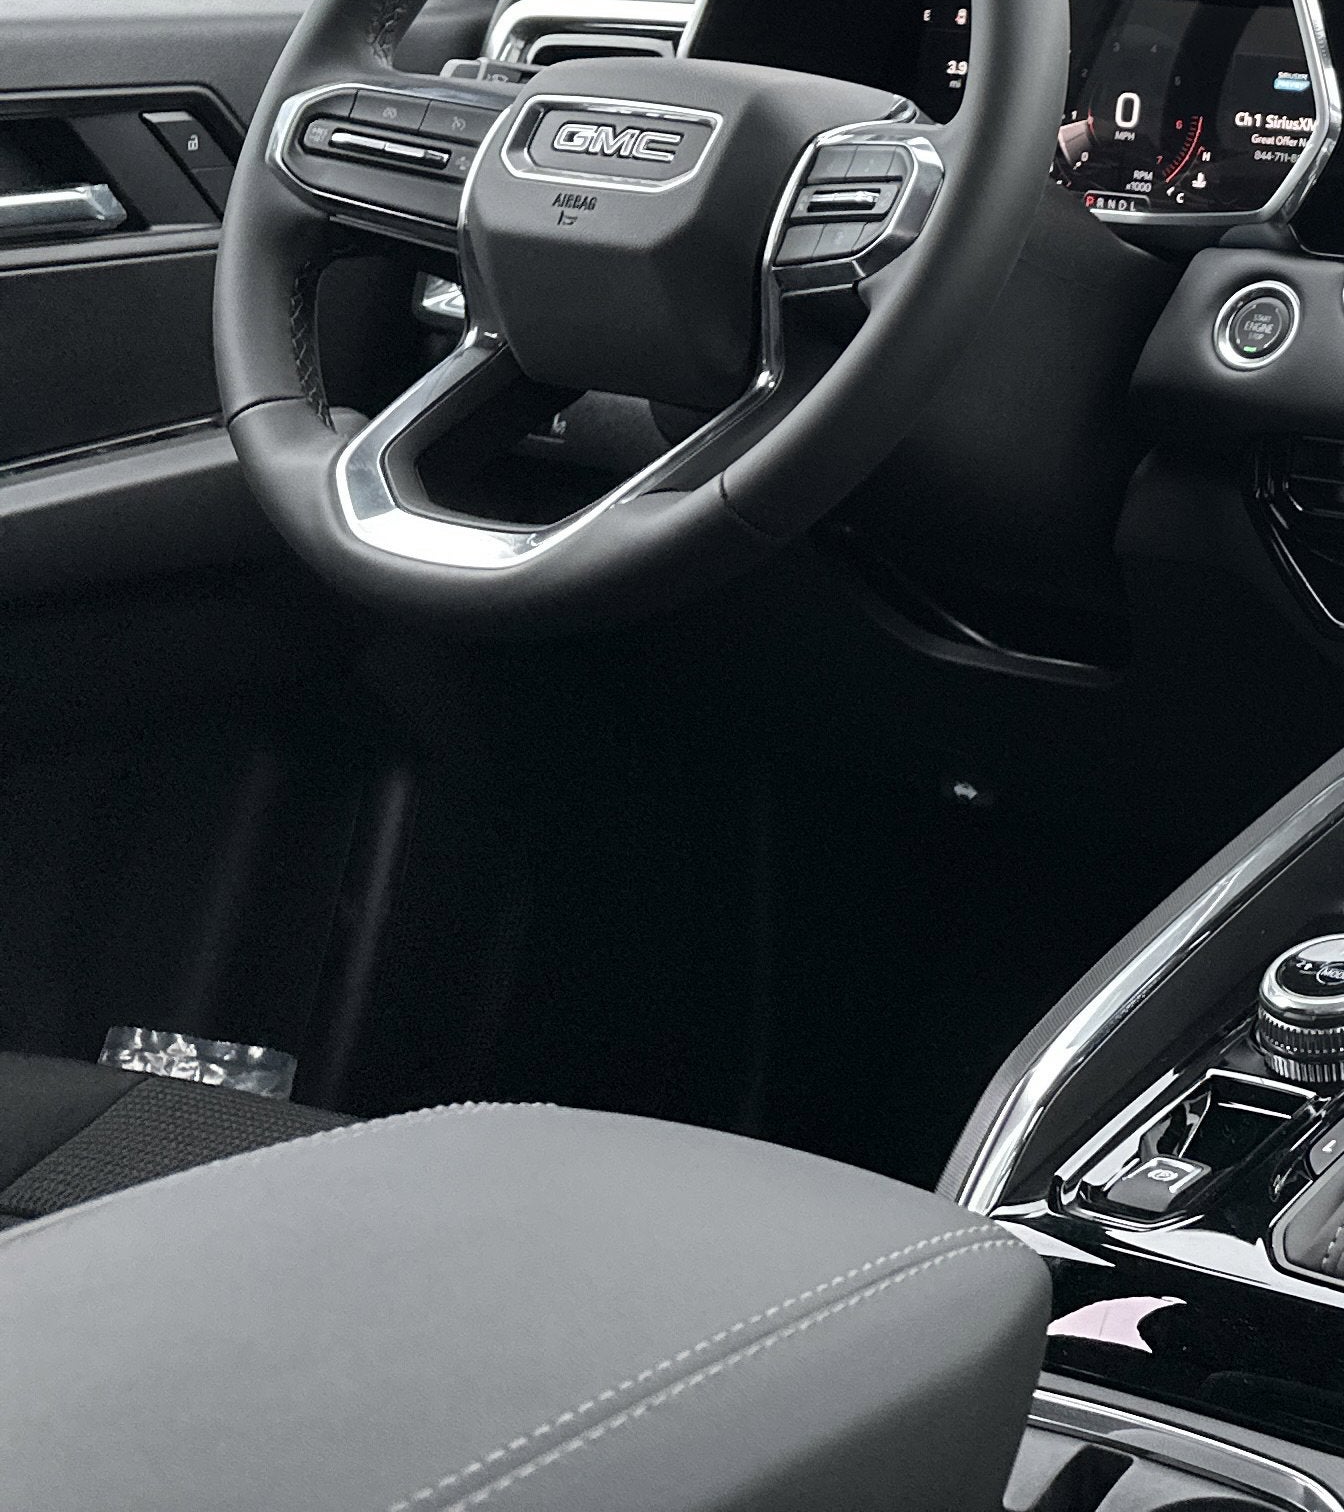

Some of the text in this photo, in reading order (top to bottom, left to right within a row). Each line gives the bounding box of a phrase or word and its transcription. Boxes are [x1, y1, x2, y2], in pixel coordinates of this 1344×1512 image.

[1115, 92, 1141, 128] 0
[1235, 111, 1253, 127] Ch
[1254, 113, 1262, 128] 1
[552, 122, 685, 164] GMC
[1114, 130, 1136, 141] MPH
[1251, 133, 1276, 145] Great
[551, 191, 597, 211] AIRBAG
